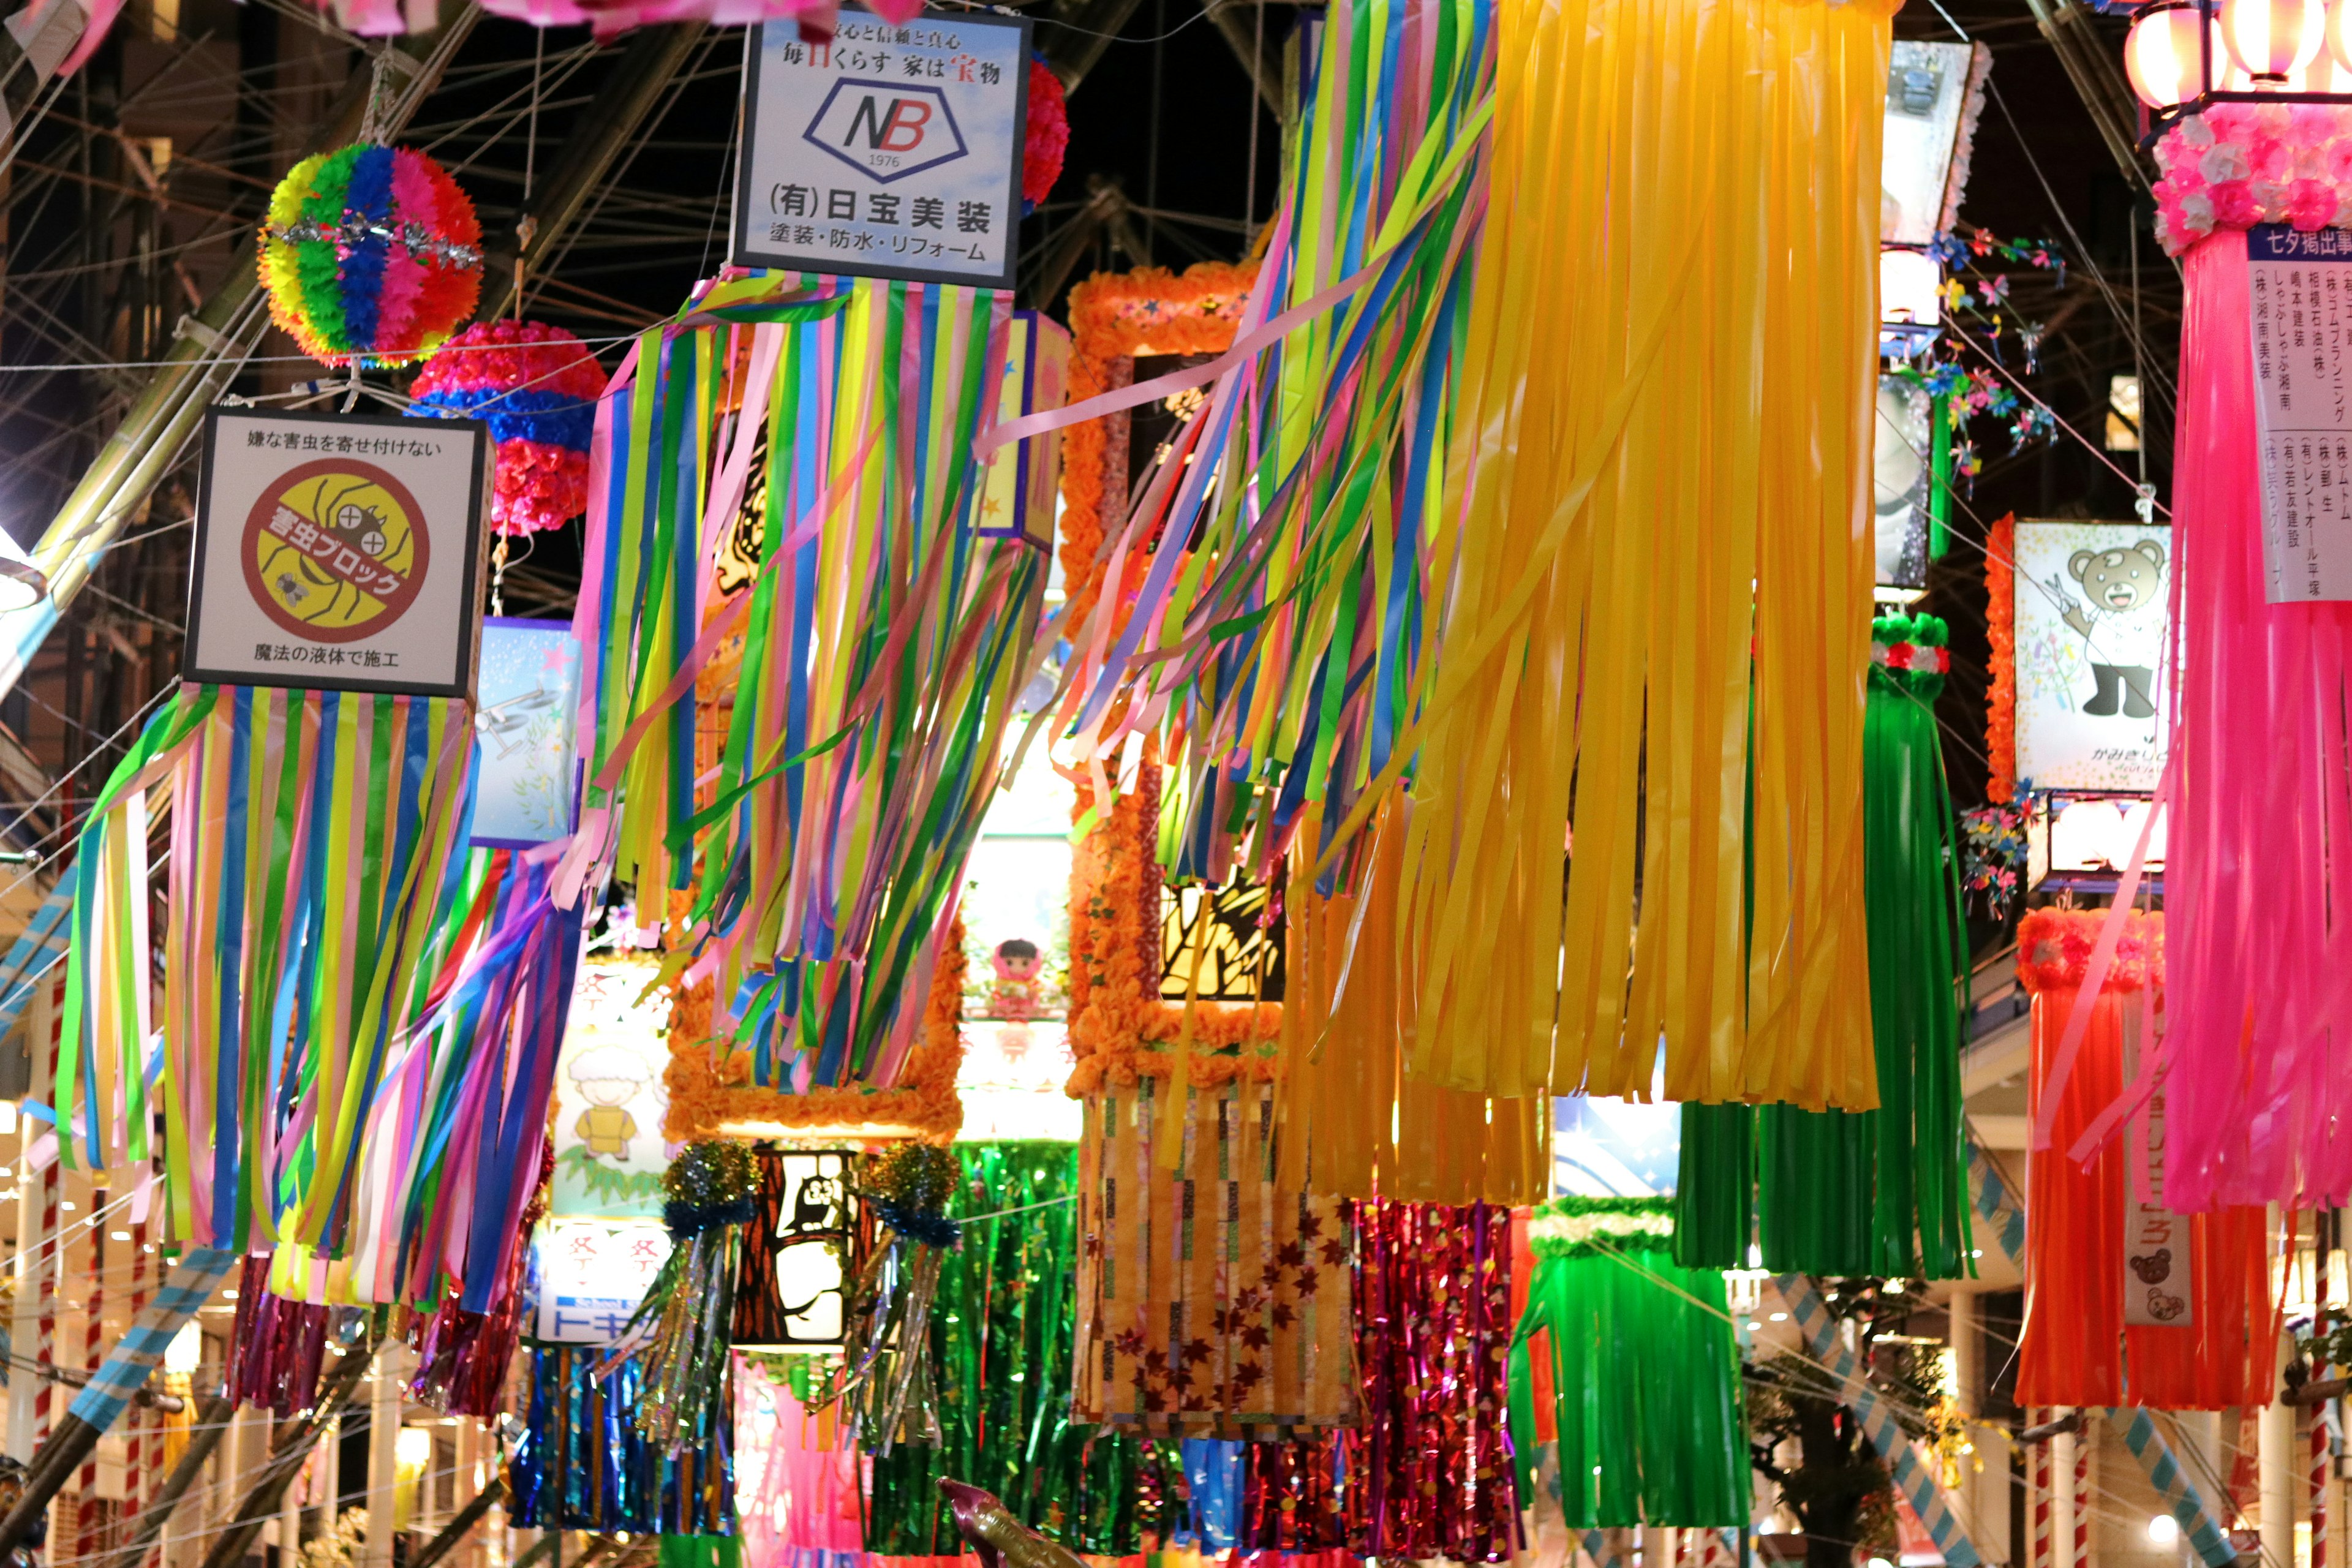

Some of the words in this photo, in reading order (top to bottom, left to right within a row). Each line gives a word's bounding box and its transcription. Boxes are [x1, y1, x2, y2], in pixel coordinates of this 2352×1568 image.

[783, 41, 892, 73] 毎日くらす
[903, 53, 1000, 85] 家は宝物
[843, 96, 932, 152] NB
[869, 154, 900, 168] 1976
[771, 183, 992, 235] (有)日宝美装
[769, 222, 986, 262] 塗装・防水・リフォーム
[247, 429, 442, 457] 嫌な害虫を寄せ付けない
[269, 505, 401, 597] 害虫ブロック
[254, 643, 400, 668] 魔法の液体で施工
